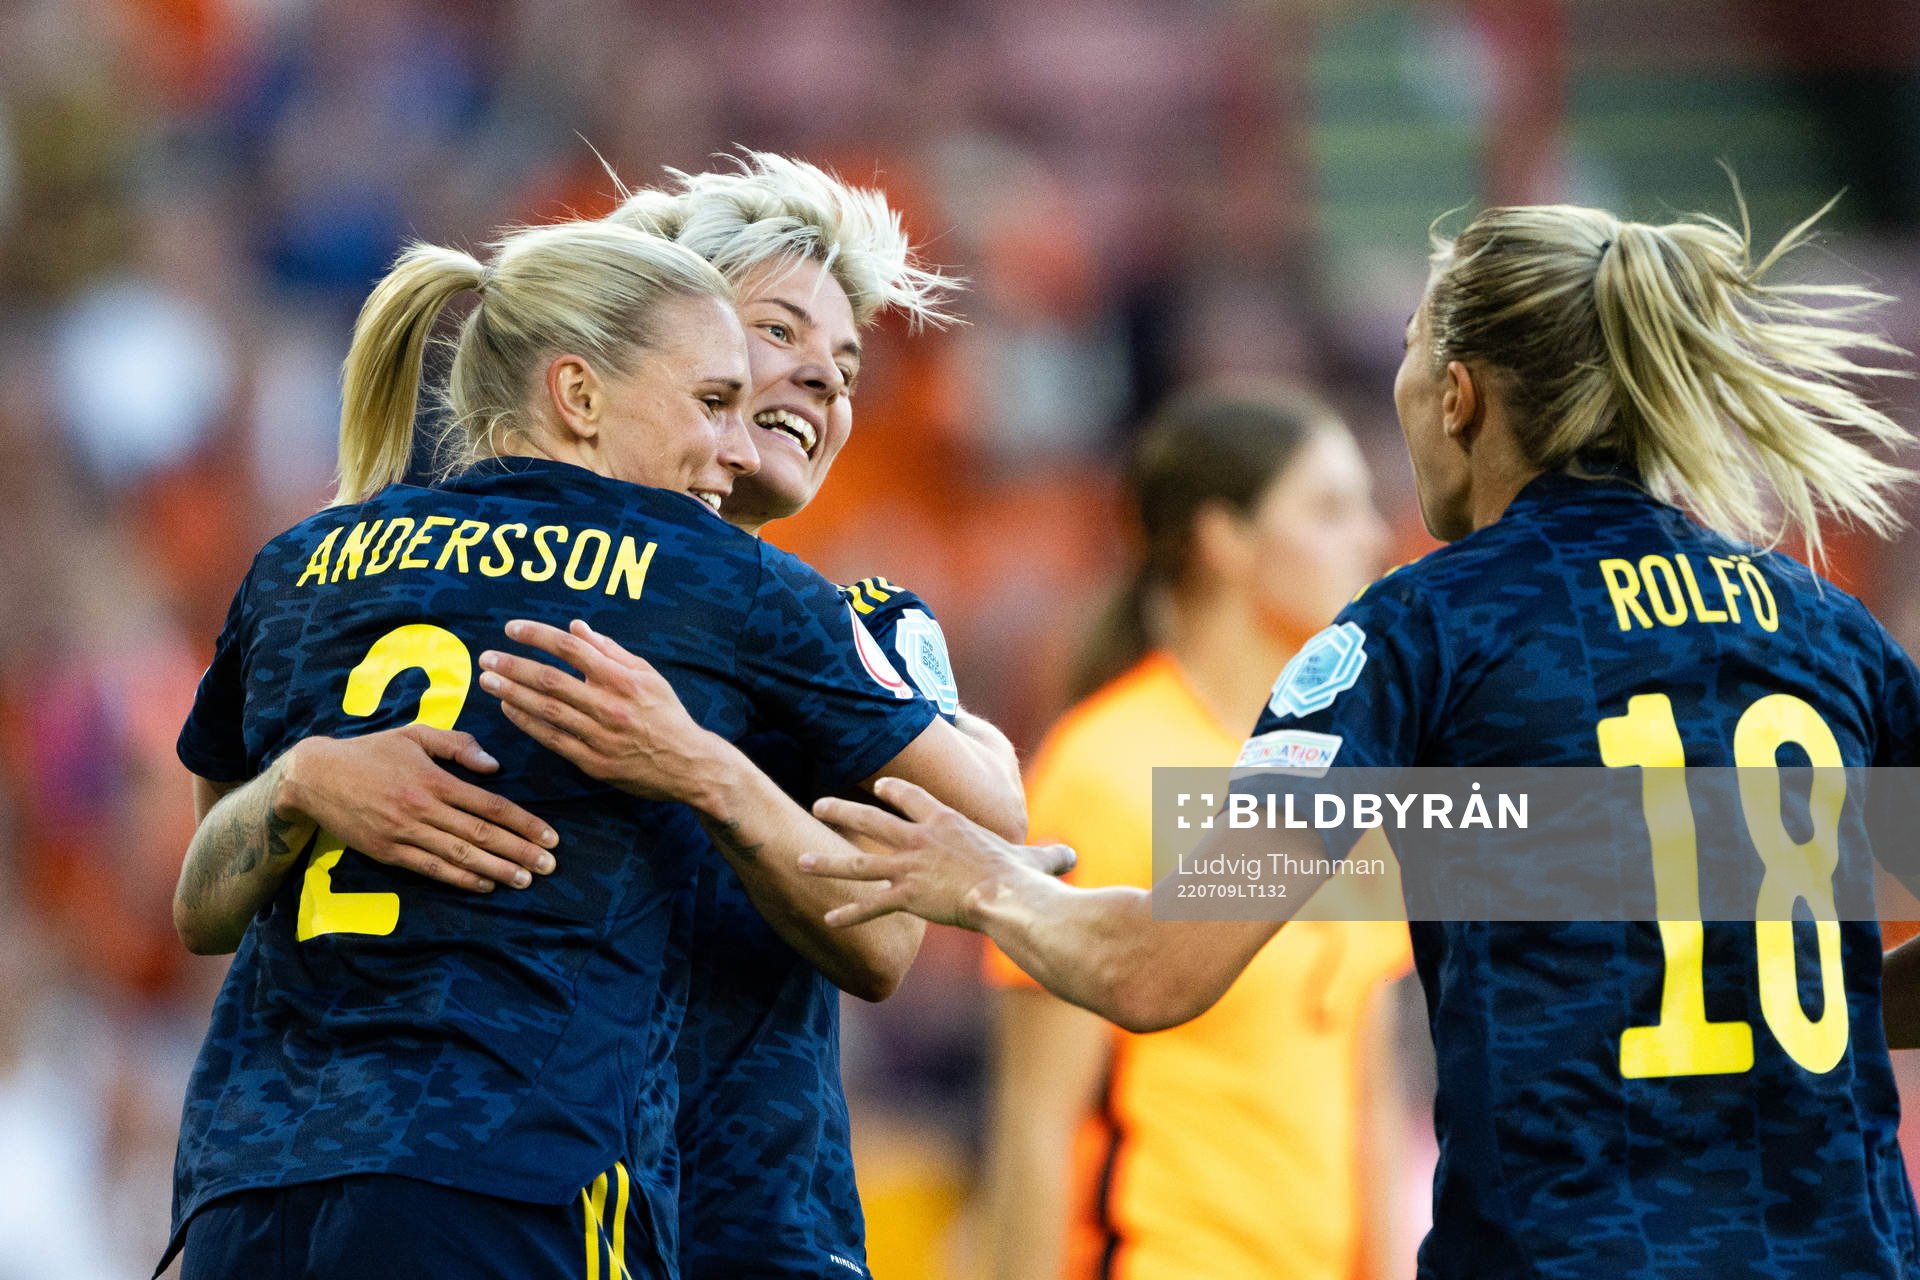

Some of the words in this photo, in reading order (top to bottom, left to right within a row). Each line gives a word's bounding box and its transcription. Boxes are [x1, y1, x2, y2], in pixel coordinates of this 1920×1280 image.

[295, 514, 658, 601] ANDERSSON
[1599, 553, 1779, 633] ROLFÖ
[297, 623, 473, 942] 2
[1239, 744, 1333, 762] FNATION
[1597, 693, 1850, 1079] 18
